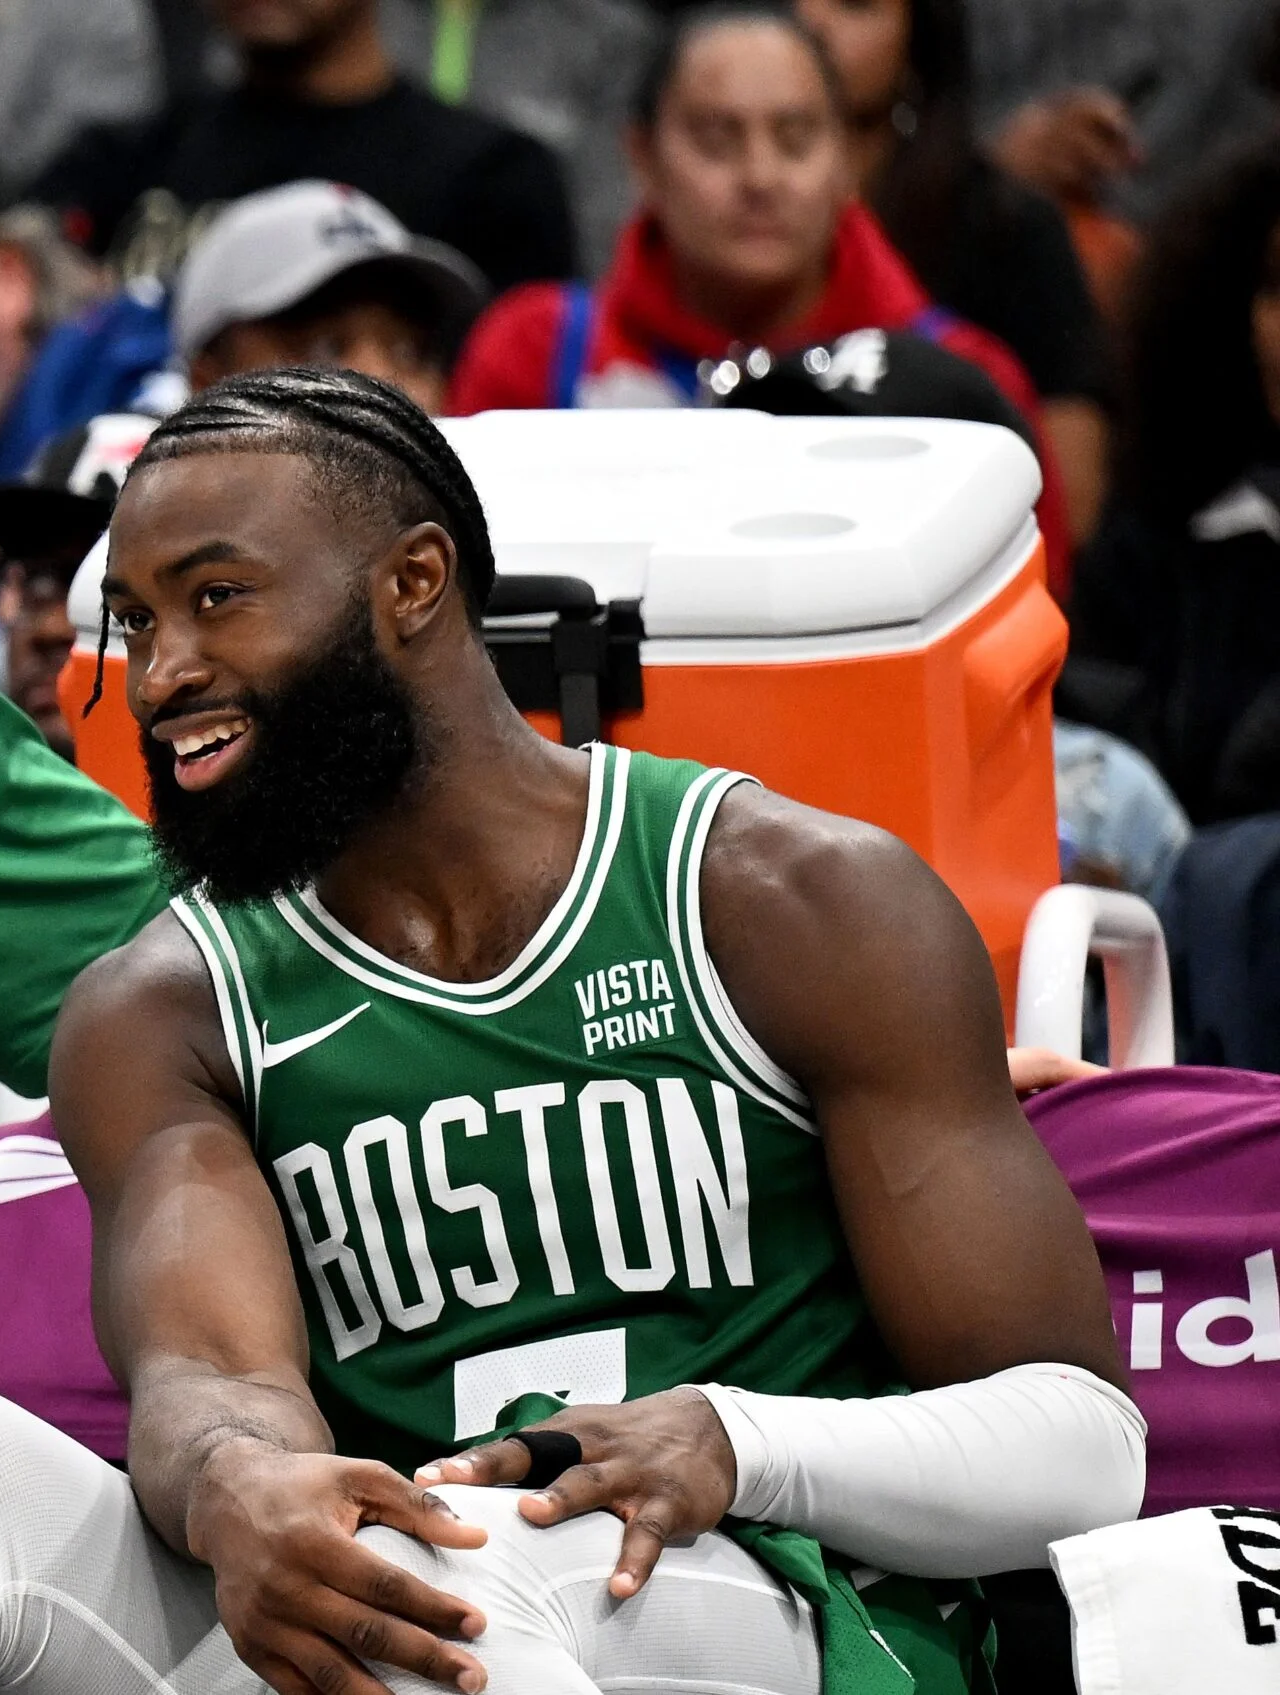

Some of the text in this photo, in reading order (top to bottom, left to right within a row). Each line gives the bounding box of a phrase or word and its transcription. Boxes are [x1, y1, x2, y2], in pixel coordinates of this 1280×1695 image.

[574, 959, 674, 1020] VISTA
[582, 1002, 676, 1056] PRINT
[272, 1077, 755, 1363] BOSTON
